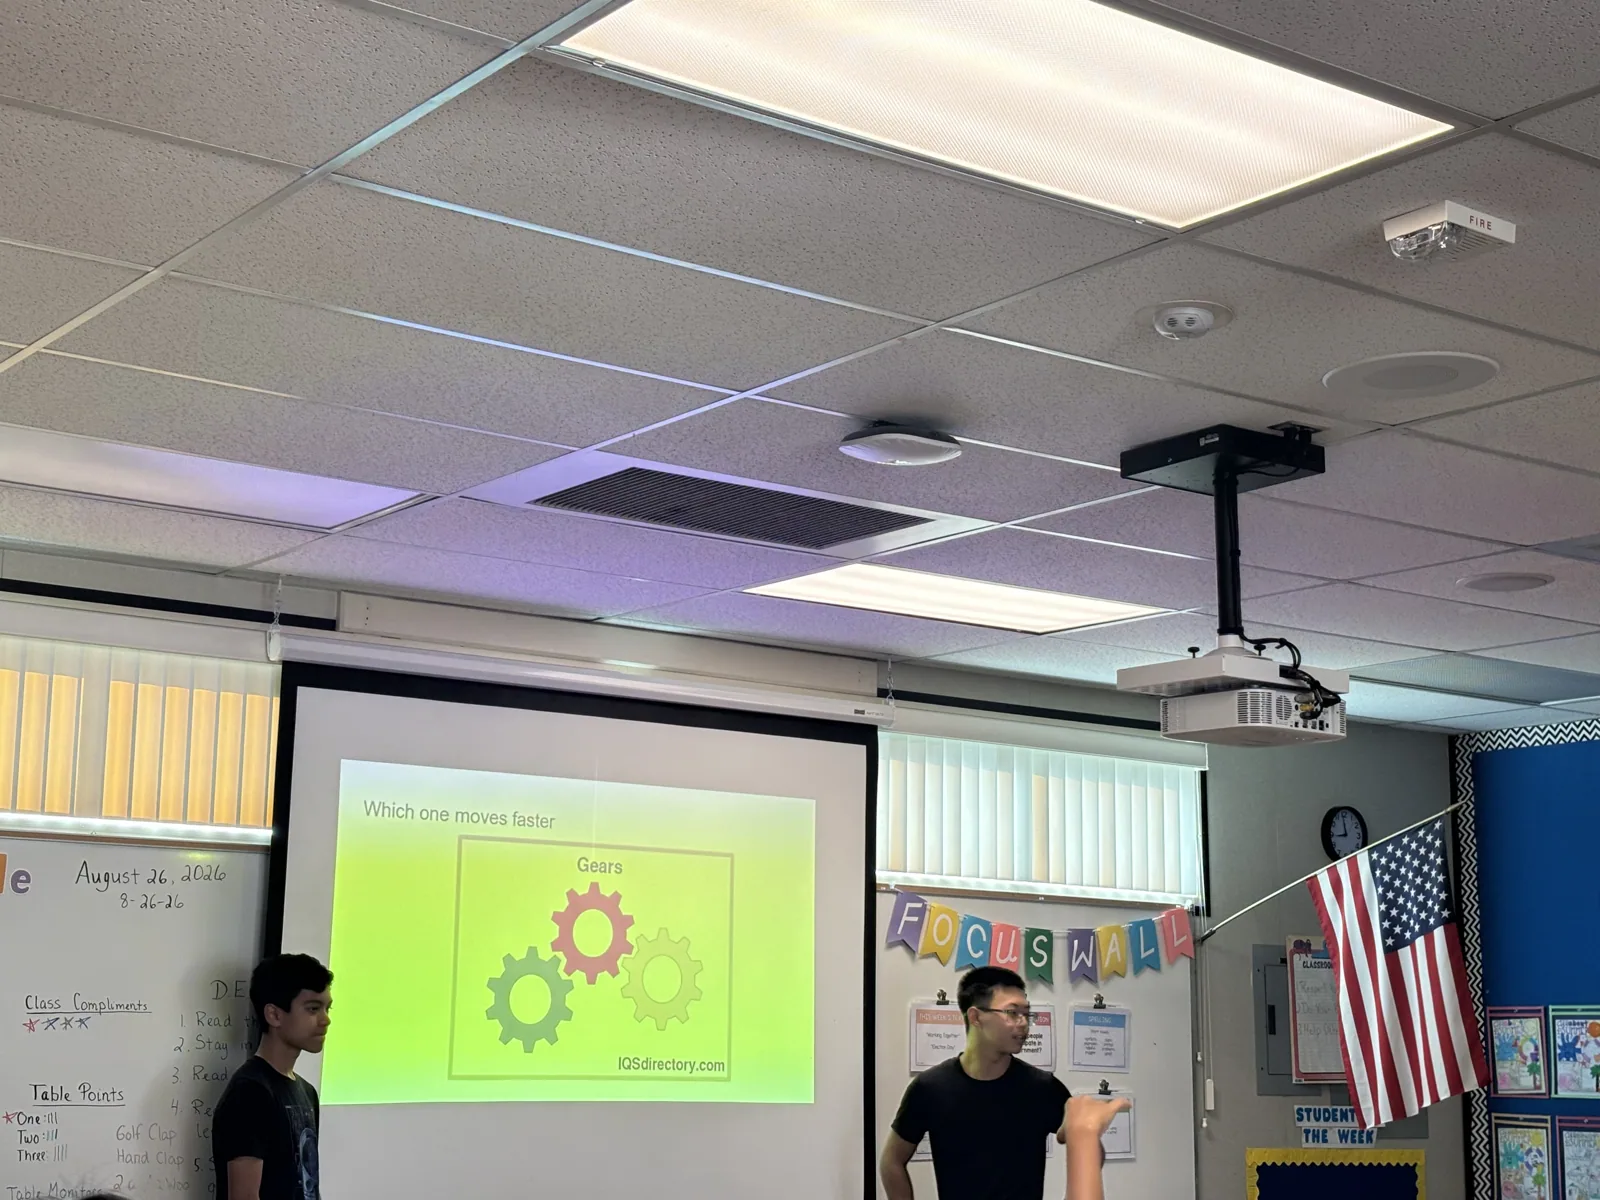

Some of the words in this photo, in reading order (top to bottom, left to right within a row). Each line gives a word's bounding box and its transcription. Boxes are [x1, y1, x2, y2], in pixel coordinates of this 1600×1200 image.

[1470, 216, 1492, 230] FIRE
[363, 800, 414, 819] Which
[419, 808, 450, 822] one
[455, 810, 508, 825] moves
[512, 811, 556, 829] faster
[577, 857, 623, 874] Gears
[75, 860, 140, 892] August
[147, 869, 174, 885] 26,
[181, 864, 227, 882] 2026
[897, 902, 1048, 968] FOCUS
[1071, 914, 1187, 972] WALL
[1303, 960, 1333, 969] CLASSROO
[25, 994, 61, 1010] Class
[73, 992, 148, 1015] Compliments
[196, 1010, 232, 1027] Read
[196, 1034, 228, 1060] Stay
[193, 1064, 228, 1081] Read
[618, 1056, 725, 1074] IQSdirectory.com
[29, 1083, 71, 1101] Table
[78, 1082, 124, 1101] Points
[191, 1099, 216, 1117] Re
[1296, 1107, 1355, 1122] STUDENT
[116, 1123, 143, 1141] Golf
[148, 1122, 177, 1145] Clap
[1303, 1129, 1328, 1143] THE
[1338, 1128, 1374, 1144] WEEK
[116, 1148, 149, 1165] Hand
[156, 1151, 185, 1171] Clap
[6, 1184, 41, 1200] Table
